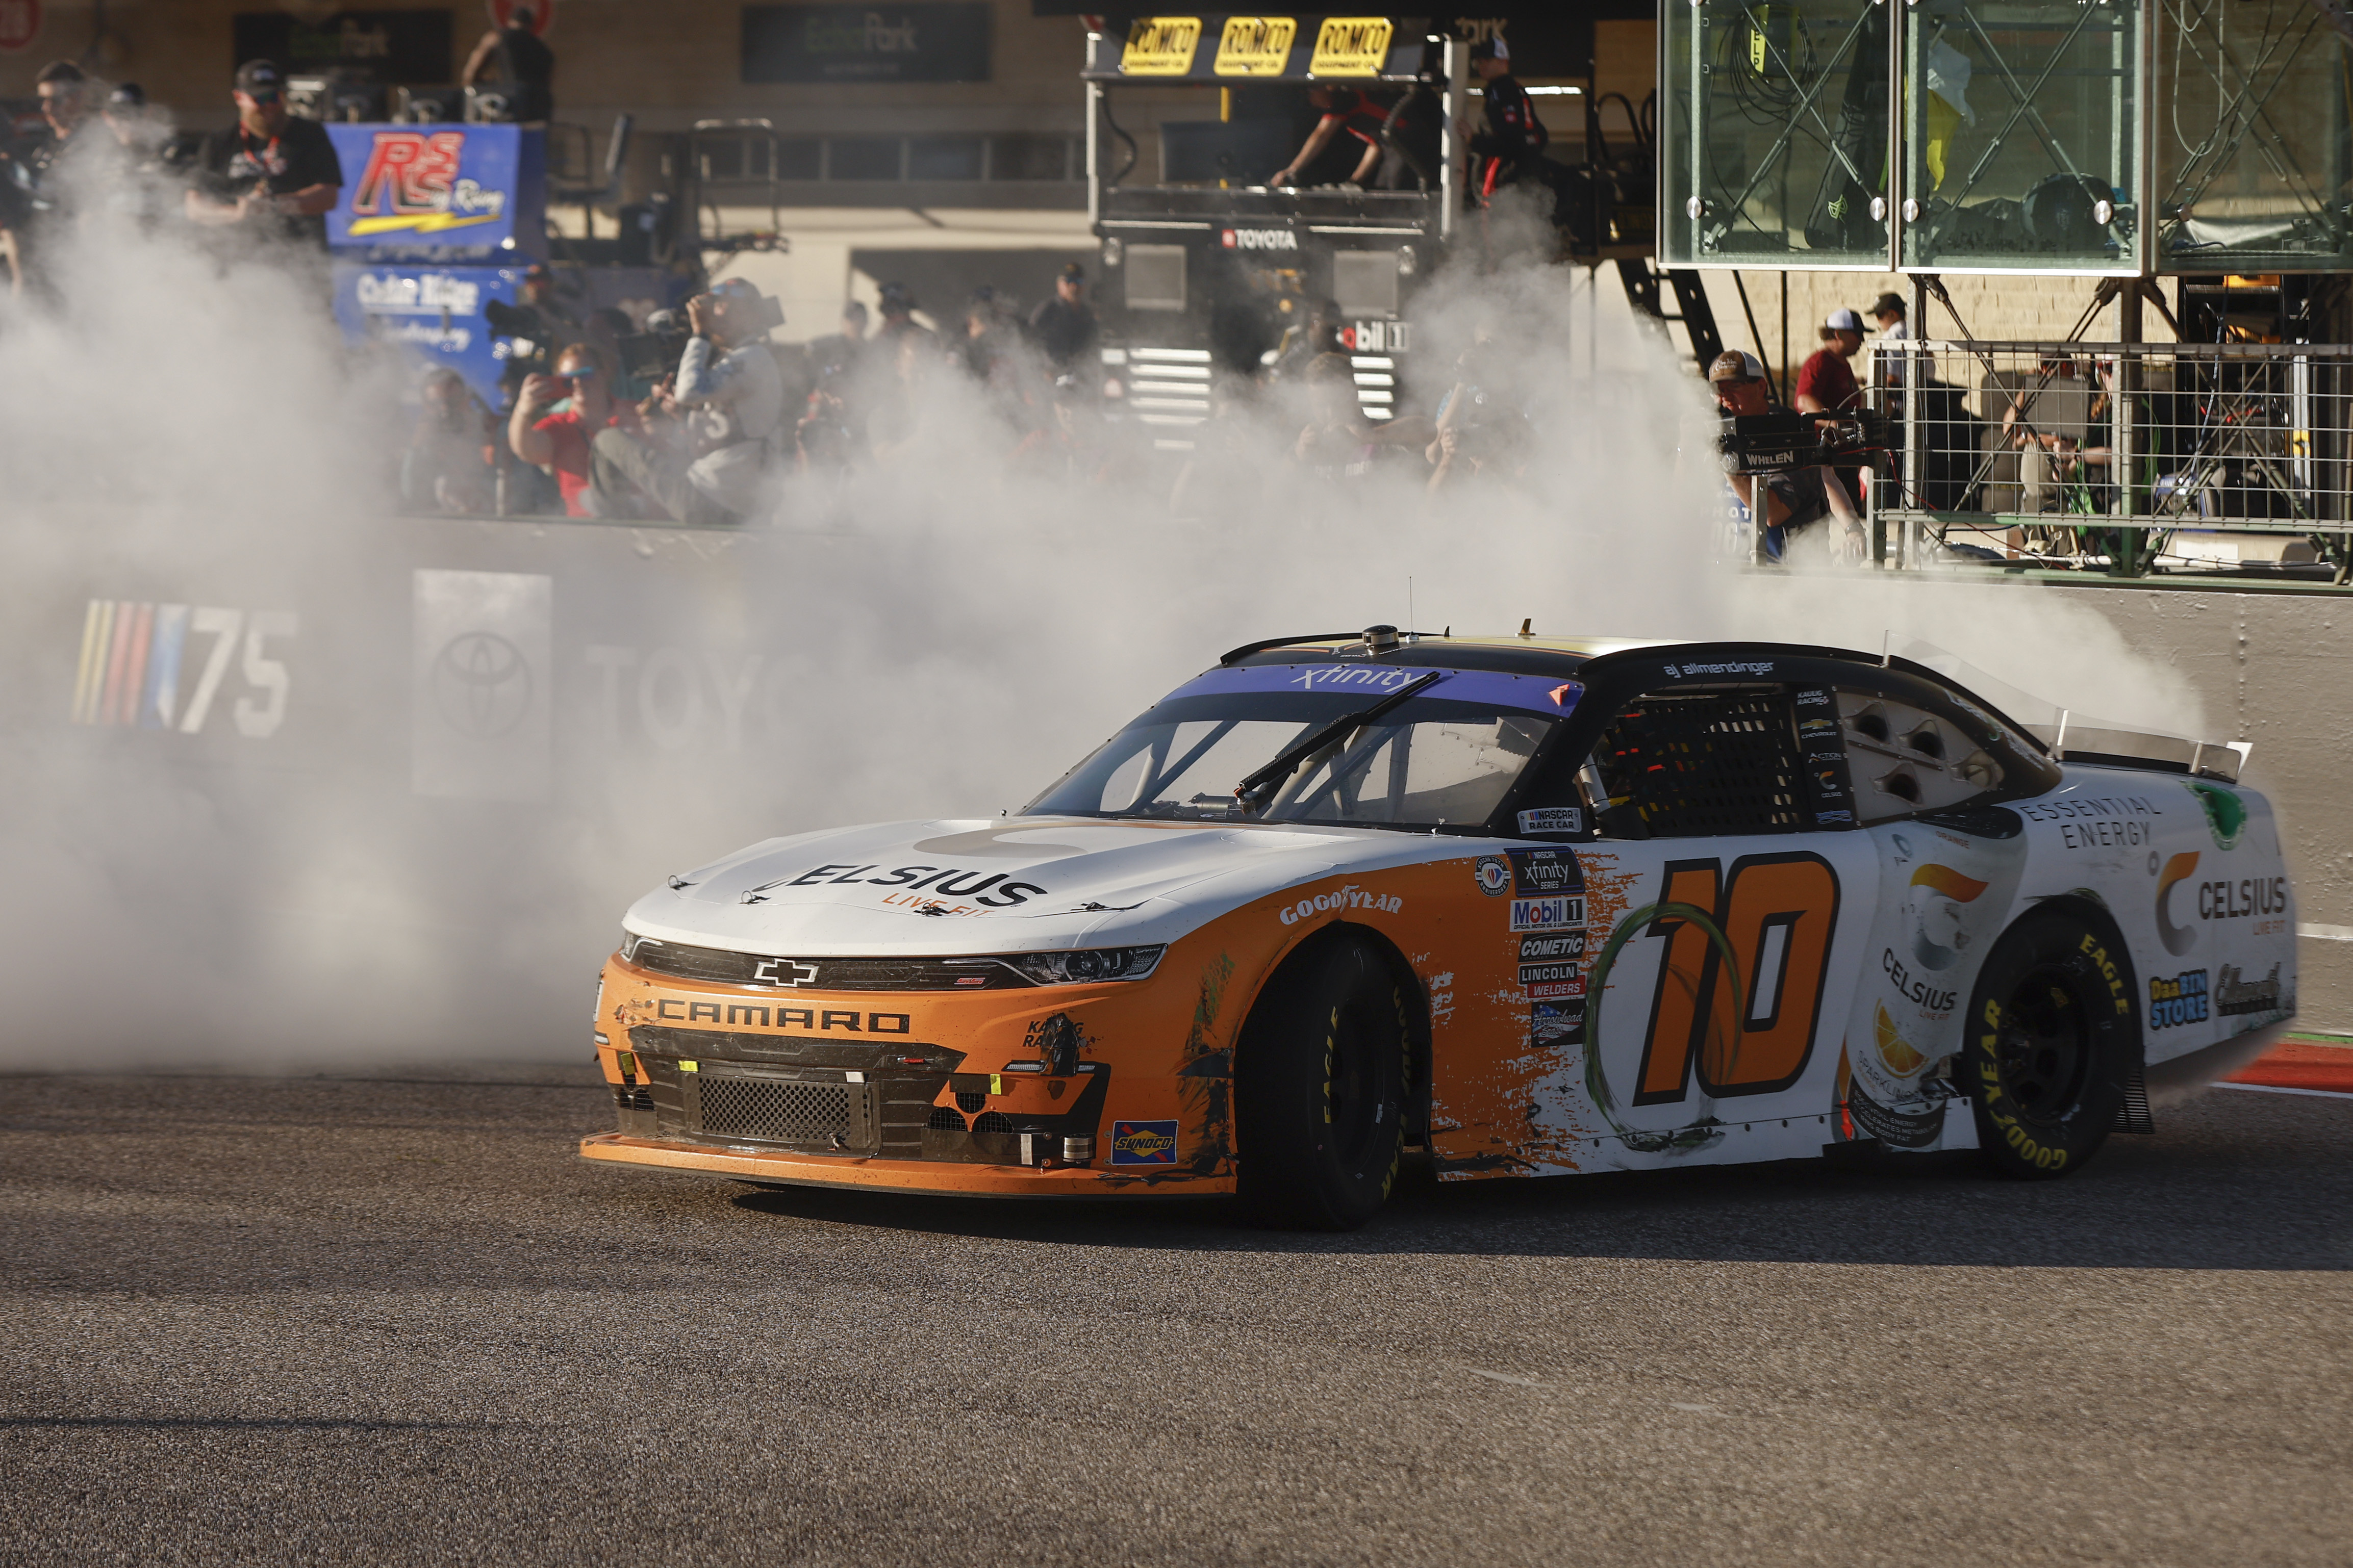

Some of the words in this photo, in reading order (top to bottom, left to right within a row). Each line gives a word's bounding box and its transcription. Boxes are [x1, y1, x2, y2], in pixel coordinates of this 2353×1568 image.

[1234, 228, 1298, 251] TOYOTA
[1335, 320, 1385, 352] obil
[1745, 450, 1794, 466] WHELEN
[178, 605, 300, 739] 75
[1290, 663, 1428, 692] xfinity
[1663, 663, 1682, 678] aj
[1682, 661, 1774, 676] allmendinger
[1797, 697, 1824, 705] RACING
[1538, 810, 1574, 820] NASCAR
[2018, 796, 2163, 821] ESSENTIAL
[1529, 821, 1554, 830] RACE
[2060, 821, 2150, 849] ENERGY
[1477, 857, 1491, 869] NASCAR
[1491, 857, 1504, 868] 75TH
[1534, 851, 1556, 859] NASCAR
[1524, 861, 1568, 885] xfinity
[1479, 881, 1508, 895] ANNIVERSARY
[1540, 881, 1559, 890] SERIES
[2199, 876, 2286, 920] CELSIUS
[1514, 900, 1561, 924] Mobil
[1521, 937, 1584, 957] COMETIC
[1522, 966, 1575, 981] LINCOLN
[1632, 851, 1841, 1107] 10
[1883, 947, 1958, 1011] CELSIUS
[2079, 933, 2130, 1015] EAGLE
[1534, 983, 1581, 996] WELDERS
[657, 998, 910, 1034] CAMARO
[1531, 1009, 1584, 1027] Arrowhead
[2150, 994, 2208, 1030] STORE
[1541, 1023, 1563, 1036] Brass
[1890, 1117, 1918, 1127] ENERGY
[1875, 1127, 1895, 1140] BODY
[1117, 1137, 1173, 1149] SUNOCO
